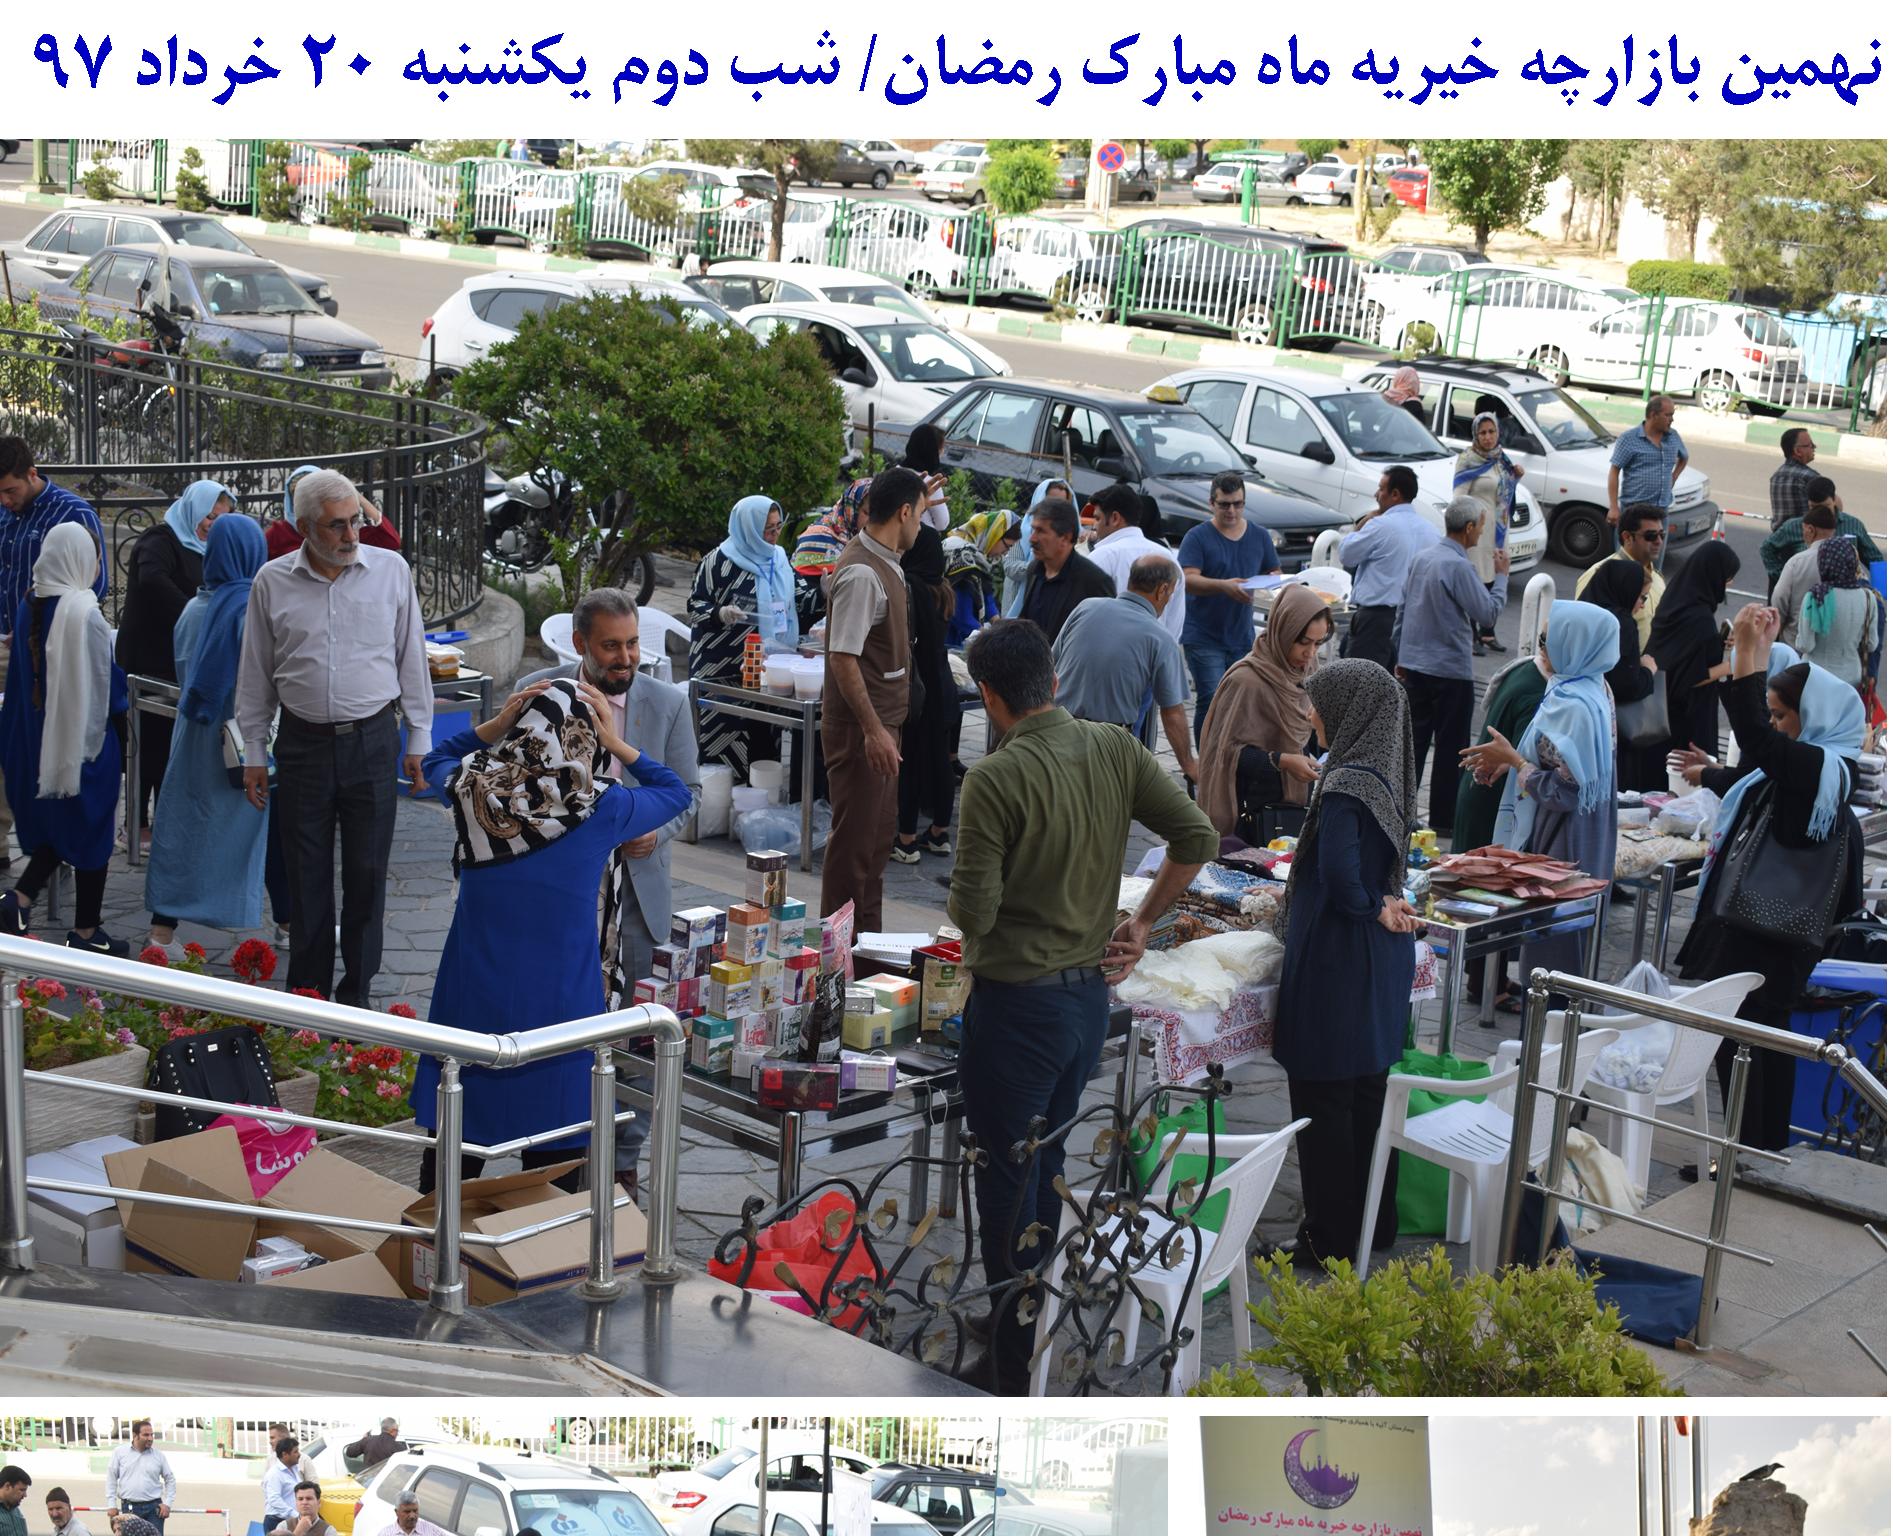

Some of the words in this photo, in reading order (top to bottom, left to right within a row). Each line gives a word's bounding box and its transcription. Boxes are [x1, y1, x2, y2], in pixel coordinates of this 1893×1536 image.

[1218, 1506, 1257, 1526] رمضان
[1260, 1510, 1294, 1528] مبارک
[1298, 1515, 1314, 1529] ماه
[1318, 1520, 1348, 1534] خیریه
